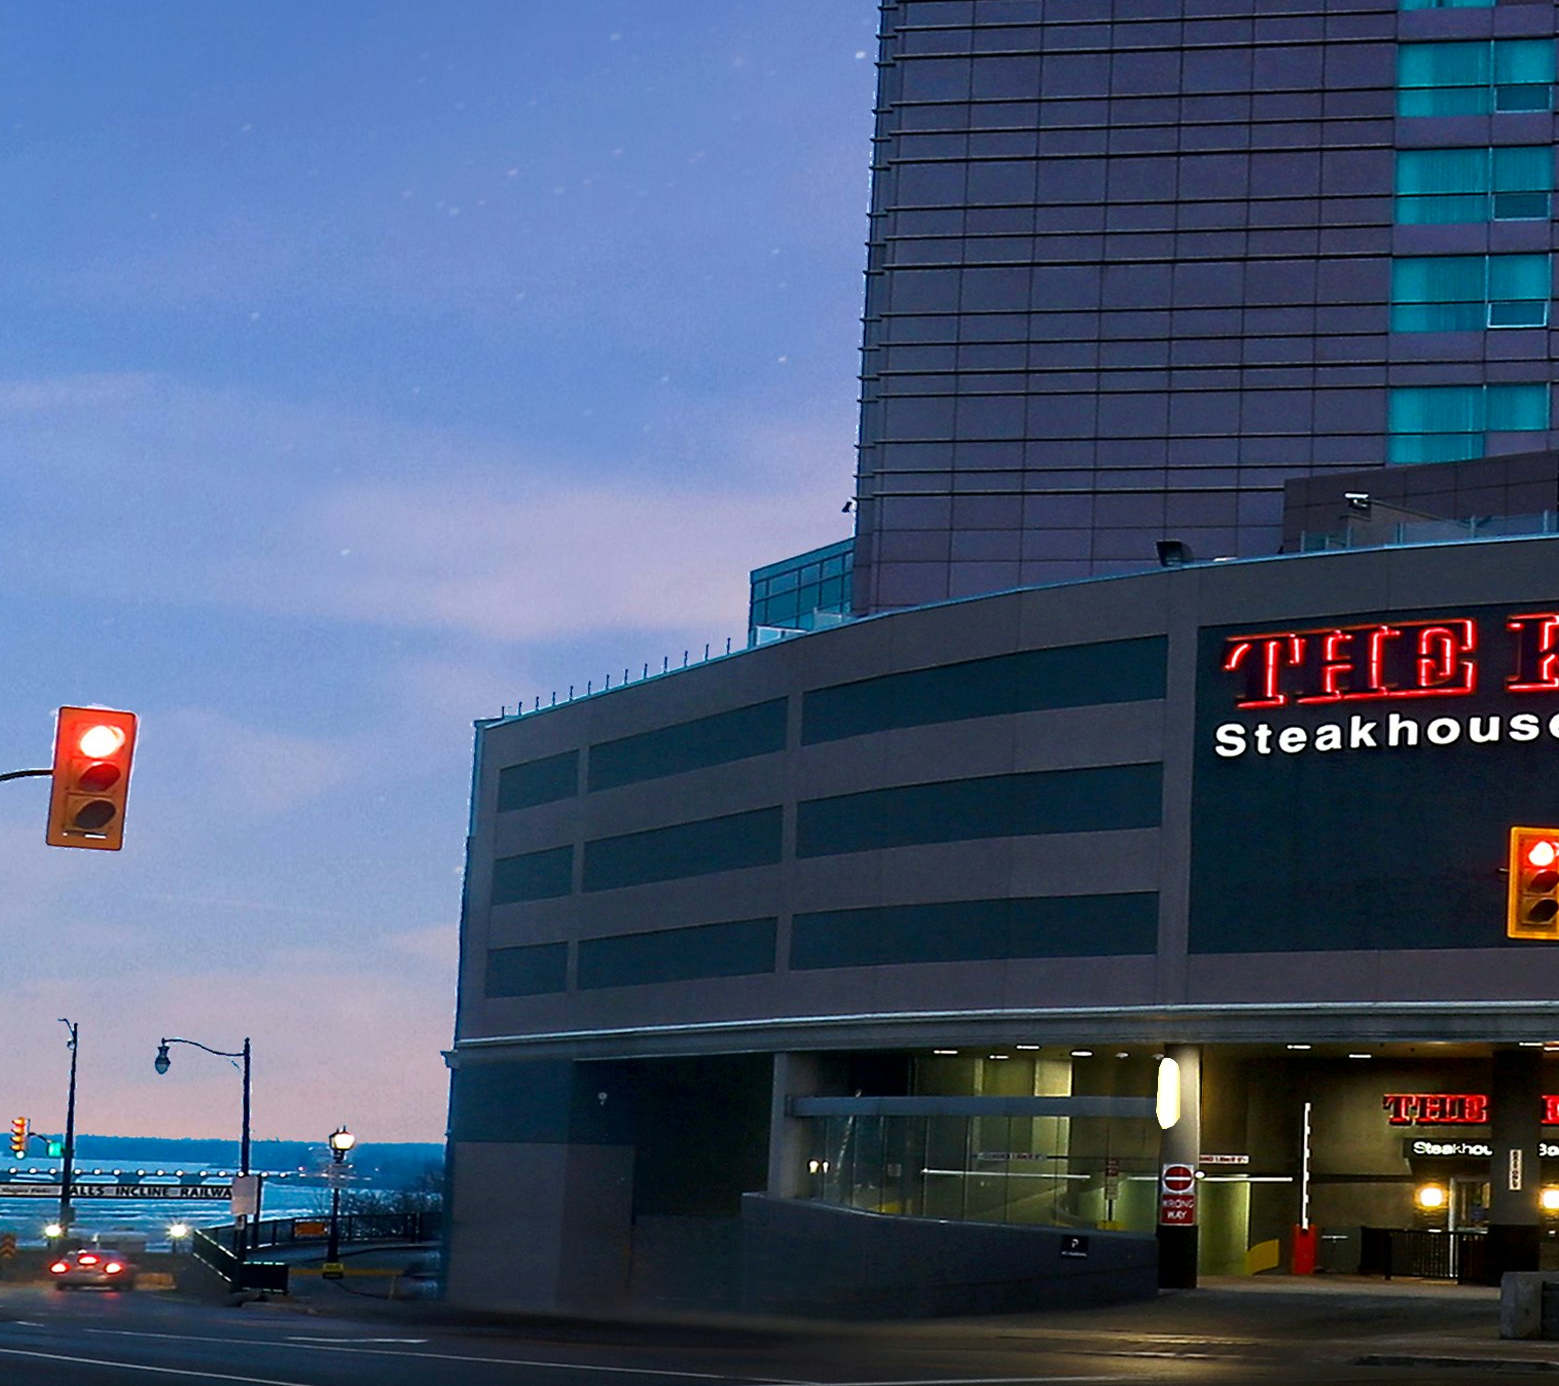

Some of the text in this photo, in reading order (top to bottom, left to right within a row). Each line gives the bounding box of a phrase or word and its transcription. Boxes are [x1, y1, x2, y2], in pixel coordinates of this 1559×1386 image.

[1221, 618, 1478, 709] THE
[1384, 1093, 1488, 1125] THE
[115, 1186, 168, 1197] INCLINE
[180, 1187, 232, 1197] RAILWA
[1163, 1199, 1194, 1208] WRONG
[1167, 1210, 1187, 1219] WAY
